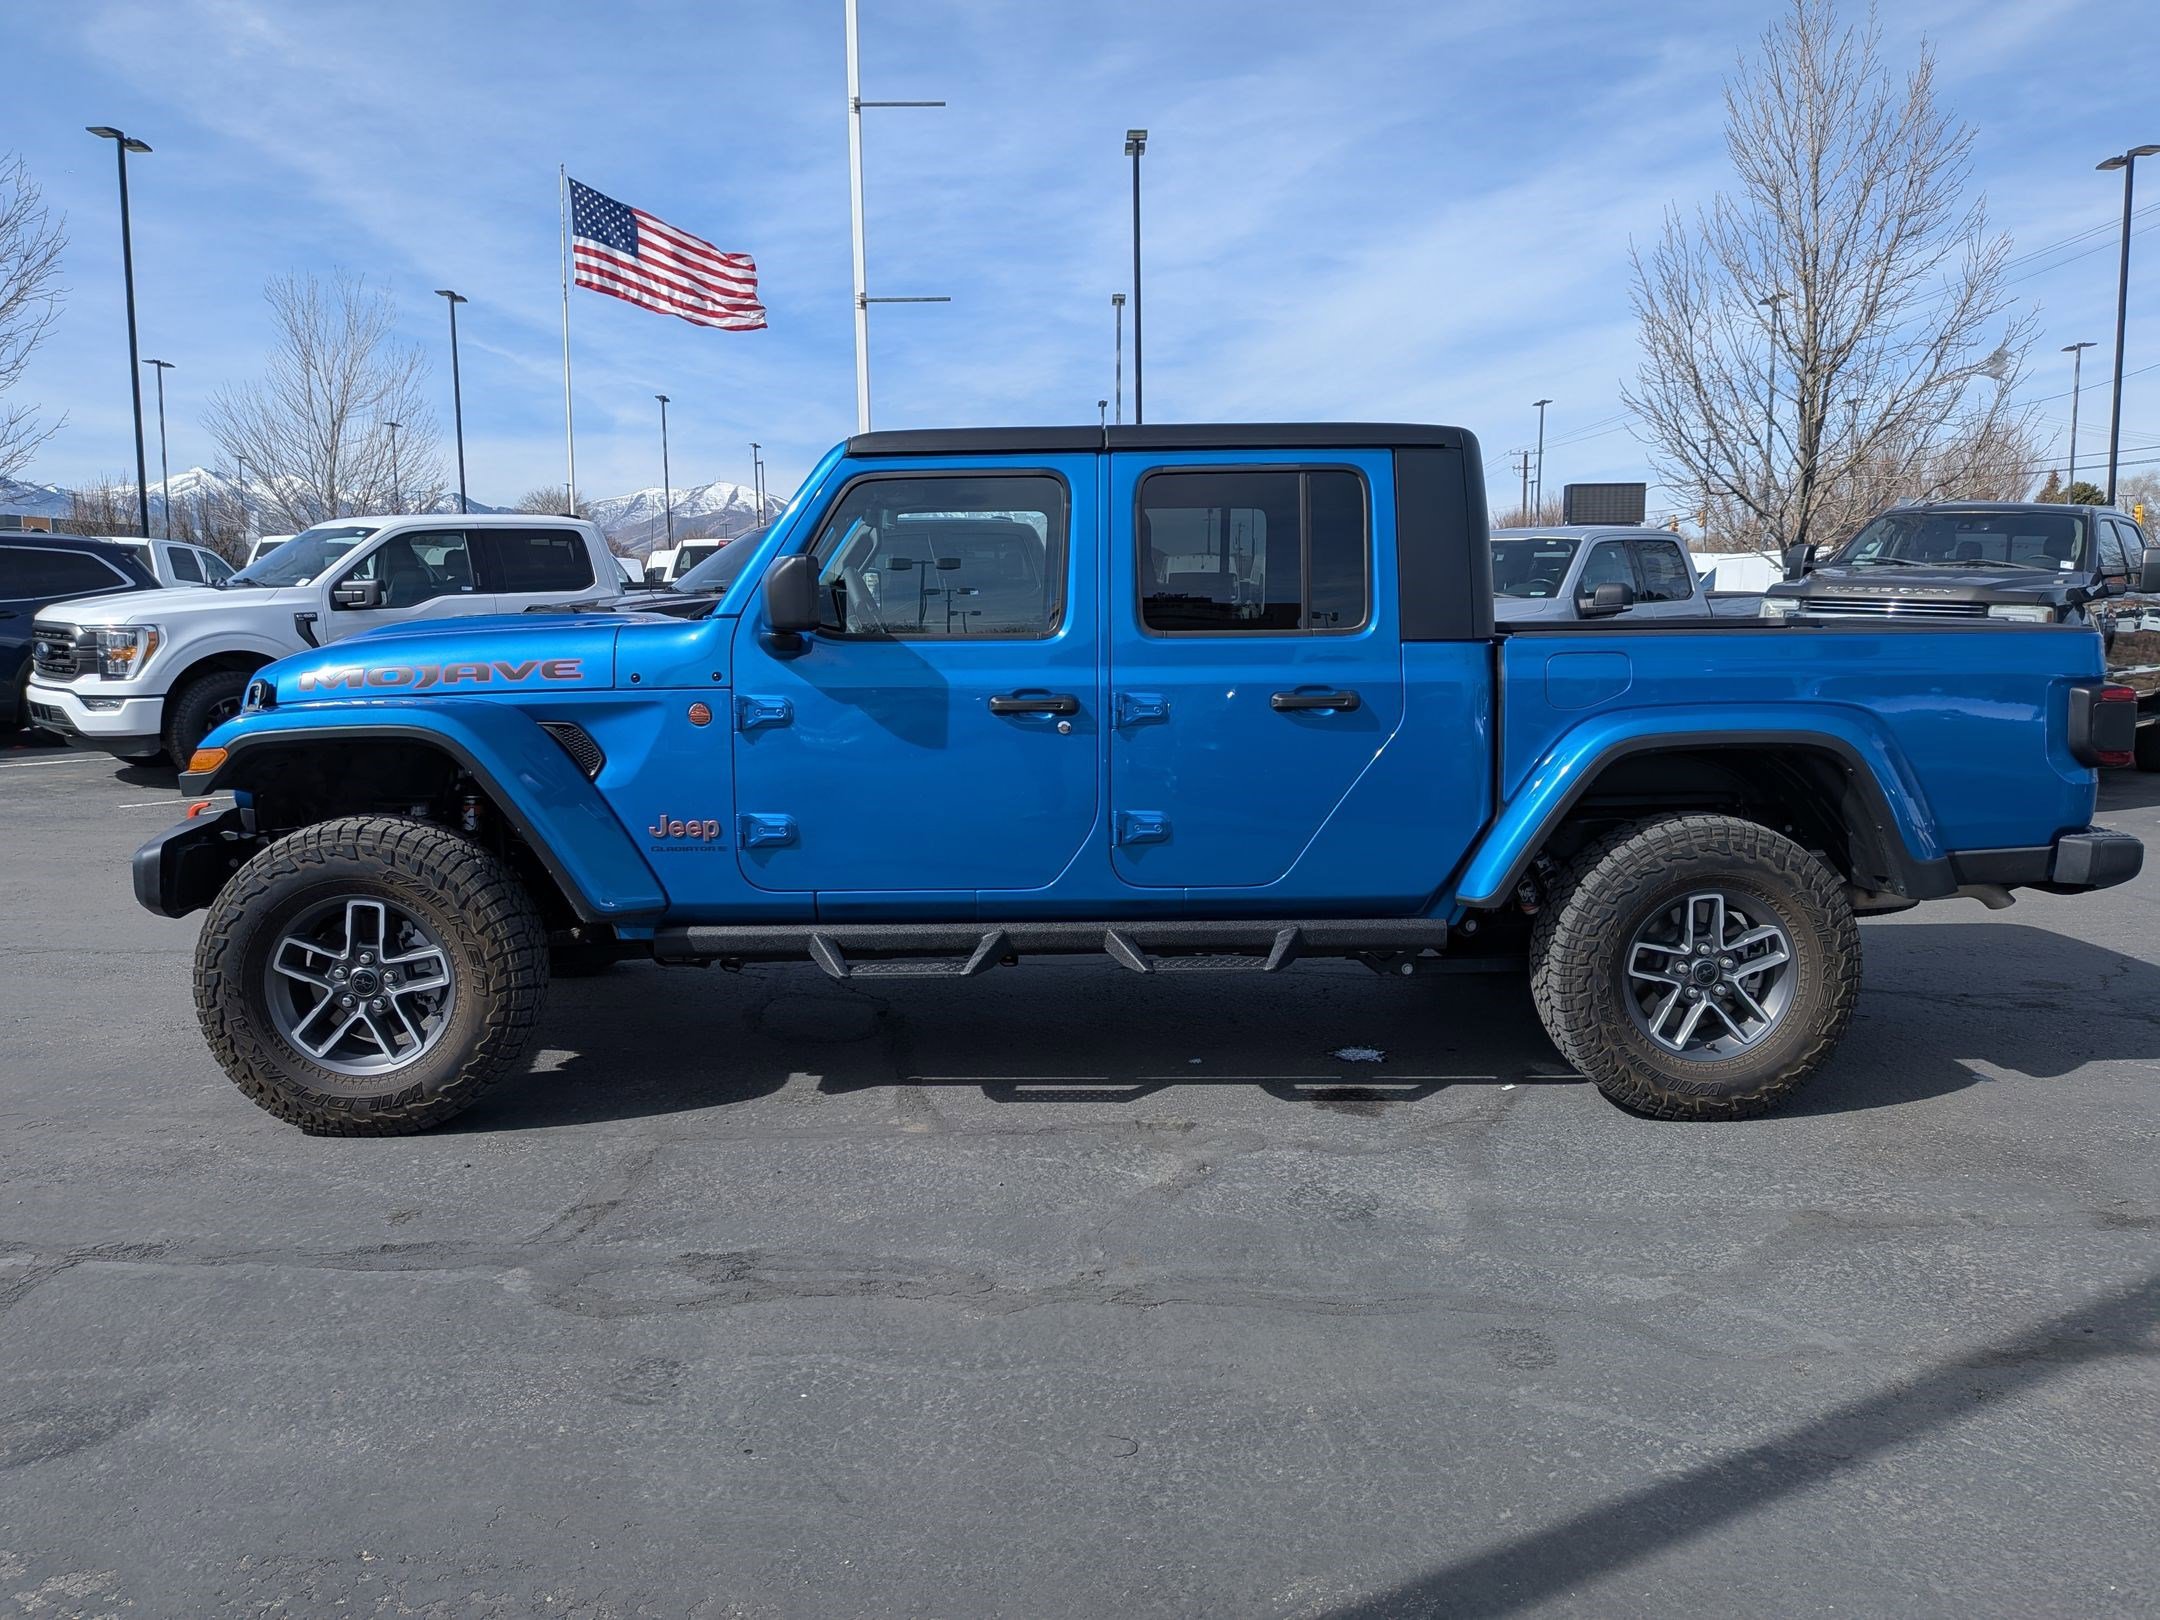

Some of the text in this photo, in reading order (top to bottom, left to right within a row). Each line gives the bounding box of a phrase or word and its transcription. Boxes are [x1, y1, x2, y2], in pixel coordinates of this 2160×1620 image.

[299, 659, 584, 691] MOJAVE
[648, 814, 720, 842] Jeep
[651, 845, 716, 853] GLADIATOR
[244, 1044, 429, 1113] WILDPEAK
